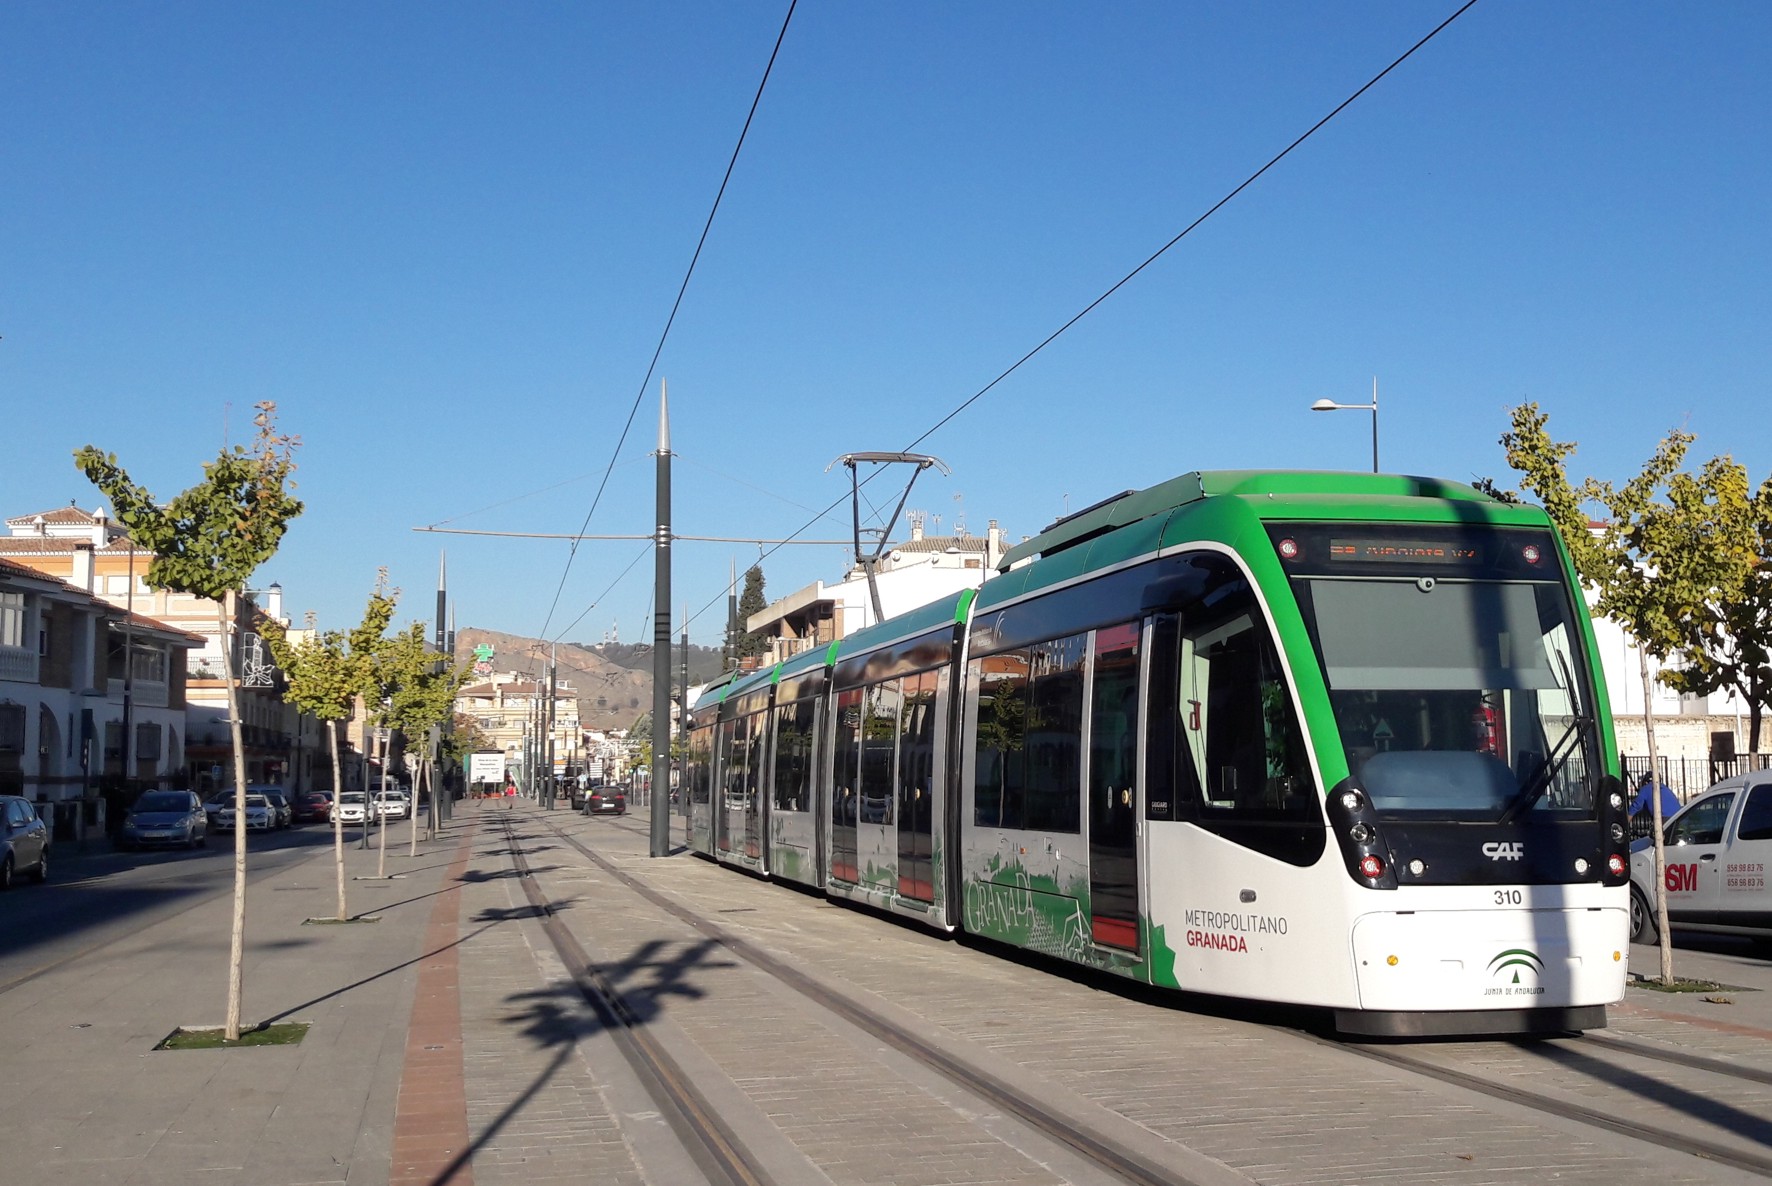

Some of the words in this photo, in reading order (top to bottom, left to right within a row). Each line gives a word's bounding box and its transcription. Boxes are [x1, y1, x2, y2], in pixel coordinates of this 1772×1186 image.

[1482, 842, 1524, 861] CAF
[1665, 863, 1698, 892] SM
[967, 869, 1036, 933] GRANADA
[1494, 889, 1522, 905] 310
[1185, 909, 1288, 935] METROPOLITANO
[1186, 930, 1248, 953] GRANADA
[1484, 987, 1503, 996] JUNTA
[1505, 987, 1513, 996] DE
